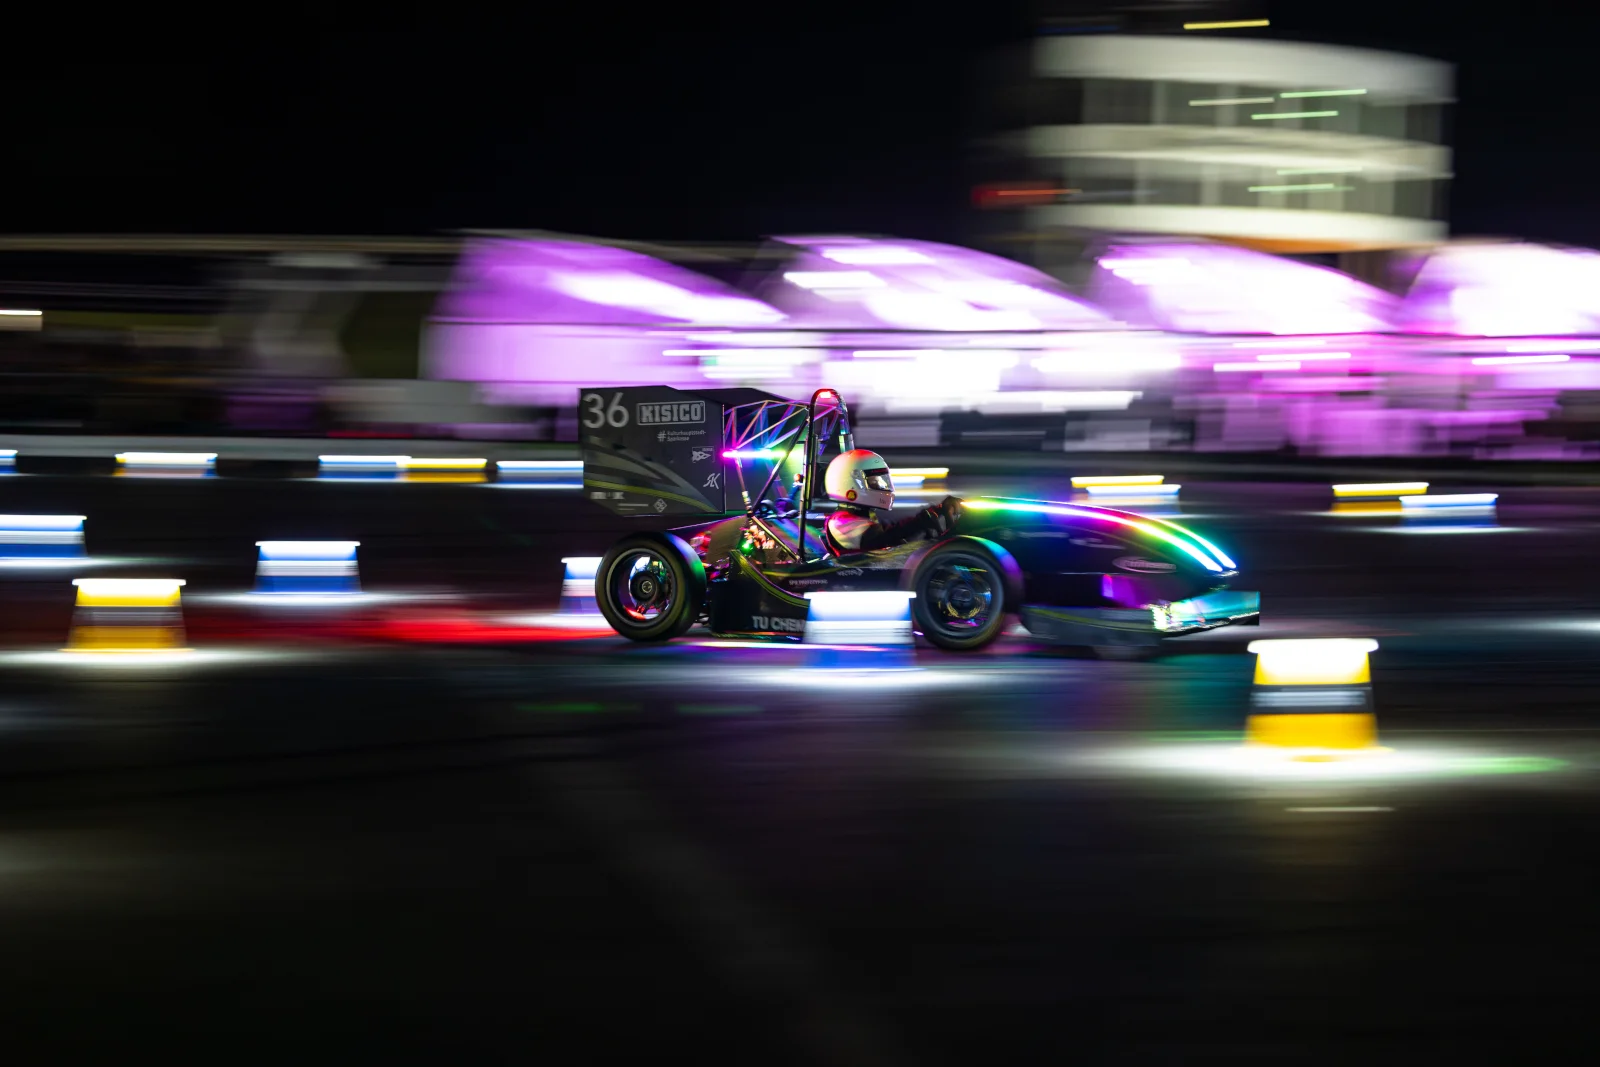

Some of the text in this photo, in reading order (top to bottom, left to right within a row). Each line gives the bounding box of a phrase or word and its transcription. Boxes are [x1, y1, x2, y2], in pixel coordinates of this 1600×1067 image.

[583, 392, 629, 428] 36
[641, 404, 702, 423] KISICO
[752, 615, 769, 630] TU
